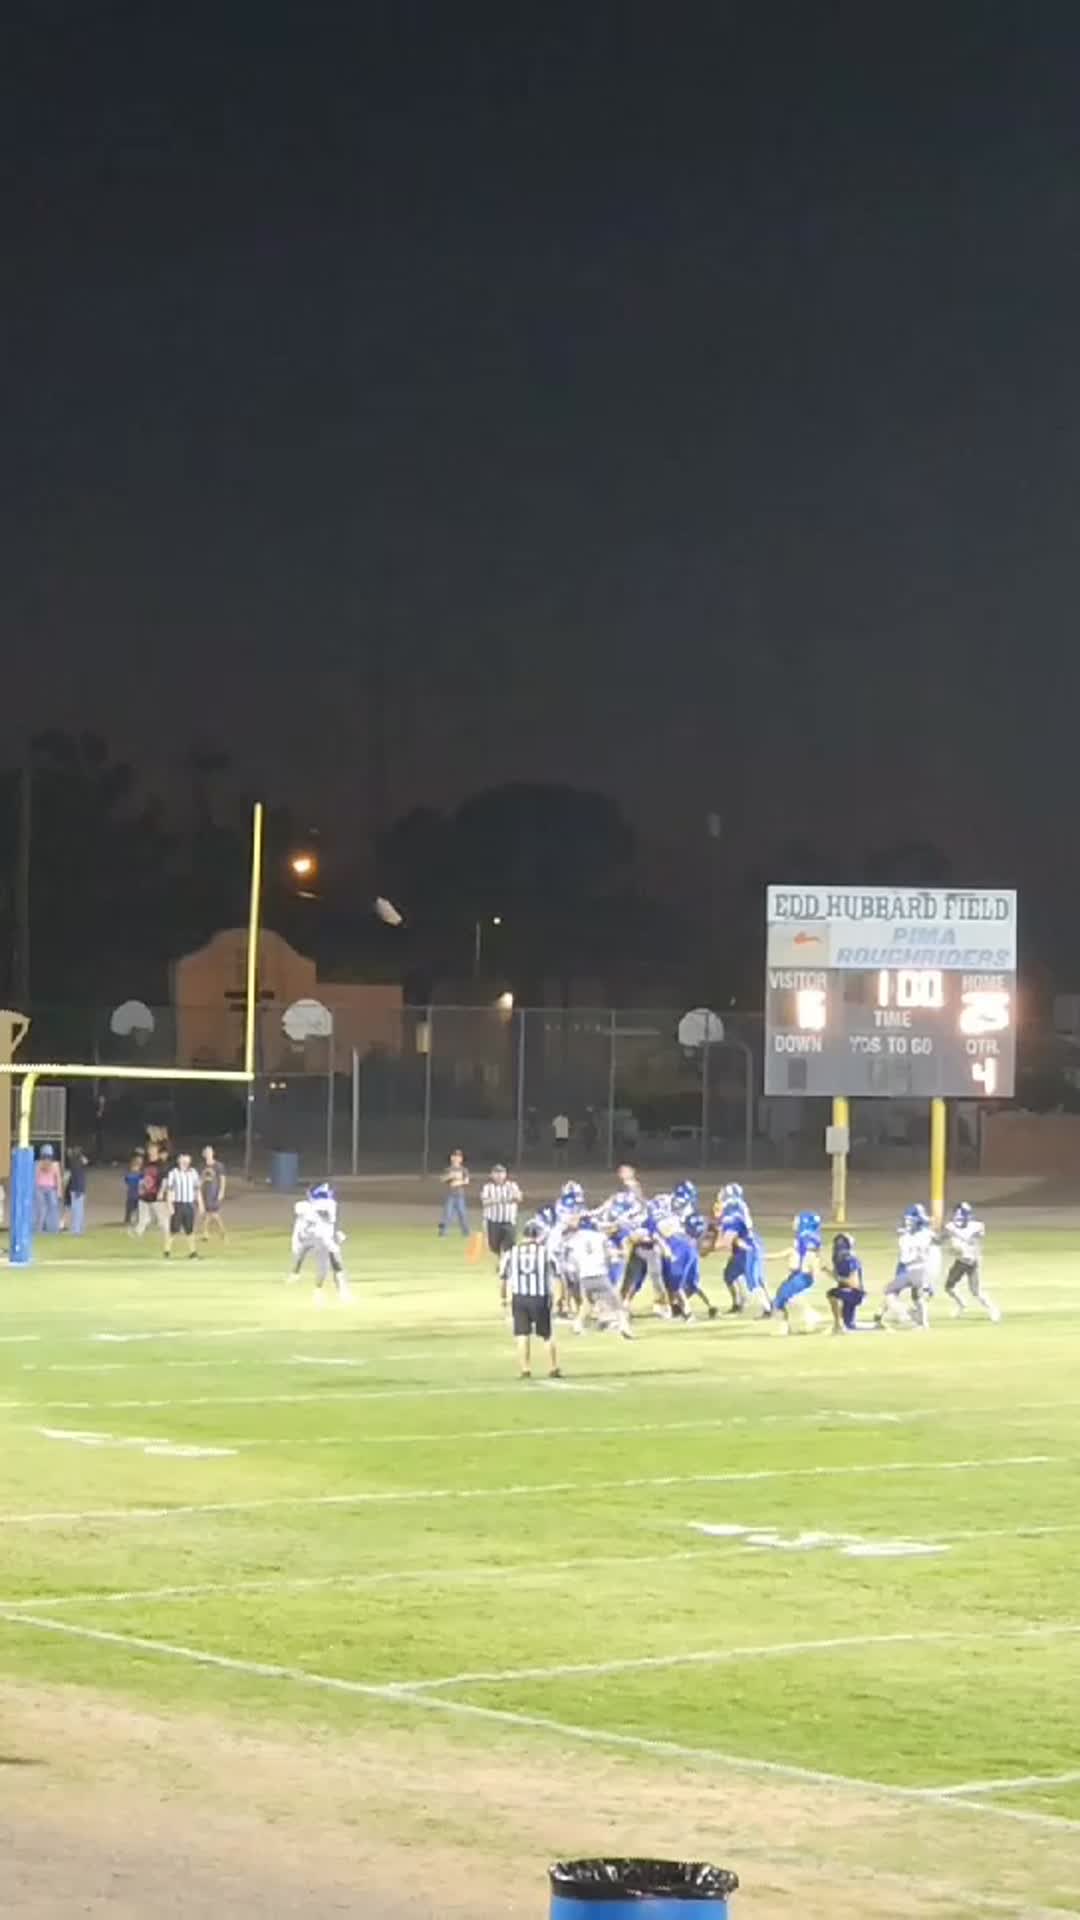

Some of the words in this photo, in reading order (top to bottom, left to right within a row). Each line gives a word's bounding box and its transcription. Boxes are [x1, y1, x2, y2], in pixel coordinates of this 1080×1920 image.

[775, 895, 819, 919] EDD
[826, 895, 937, 921] HUBBARD
[944, 895, 1009, 920] FIELD
[891, 927, 955, 945] PIMA
[837, 948, 1010, 967] ROUGHRIDERS
[769, 972, 827, 989] VISITOR
[962, 975, 1005, 990] HOME
[874, 1010, 912, 1027] TIME
[775, 1036, 822, 1052] DOWN
[850, 1036, 880, 1053] YDS
[888, 1036, 906, 1053] TO
[911, 1037, 932, 1054] GO
[971, 1057, 996, 1095] 4
